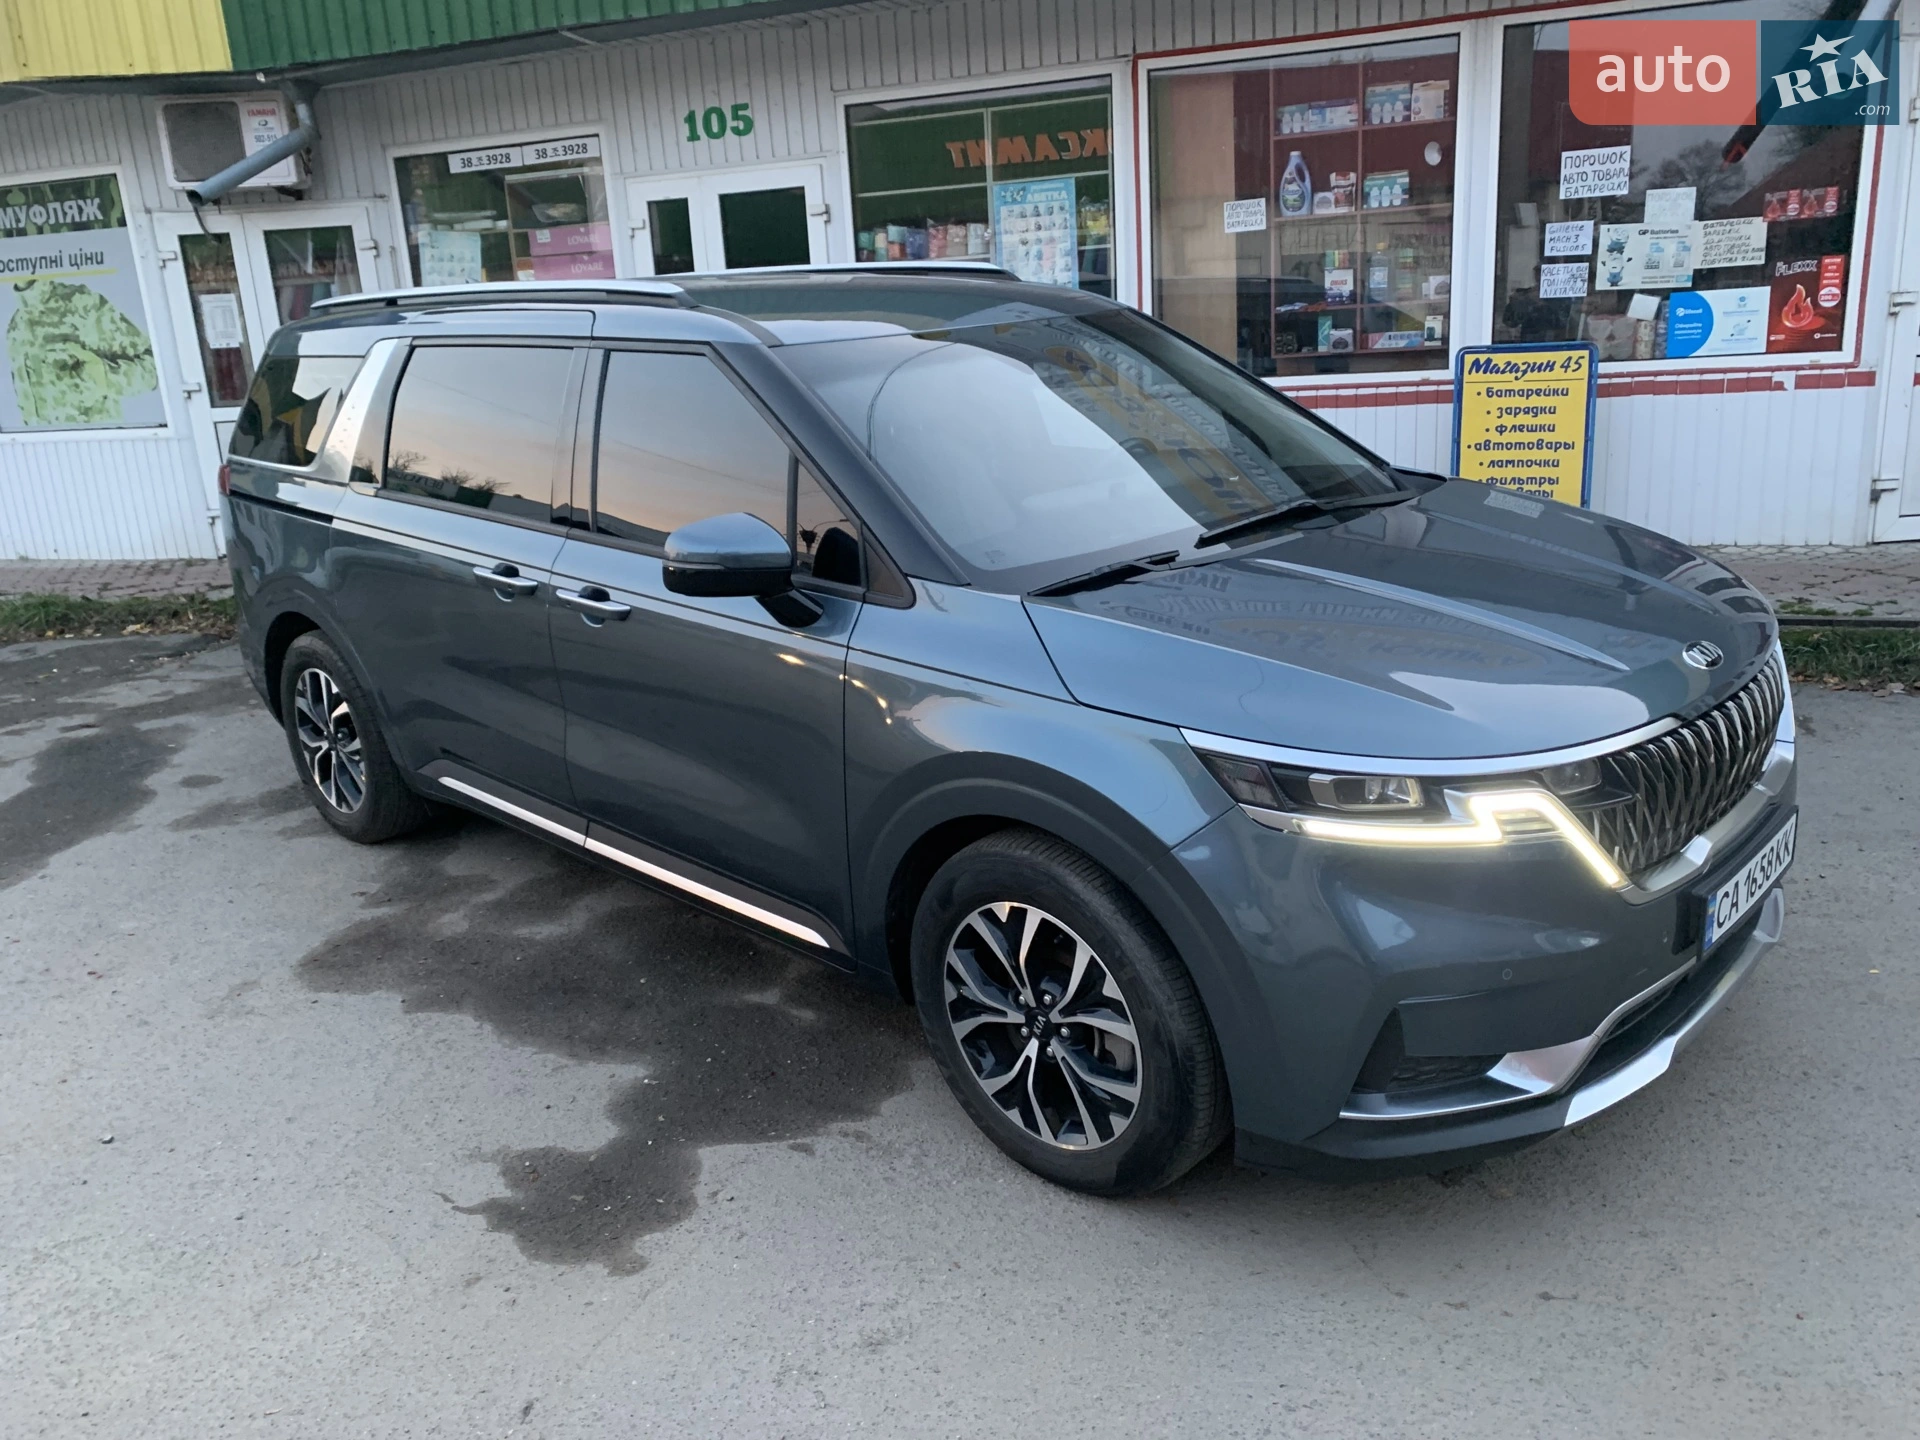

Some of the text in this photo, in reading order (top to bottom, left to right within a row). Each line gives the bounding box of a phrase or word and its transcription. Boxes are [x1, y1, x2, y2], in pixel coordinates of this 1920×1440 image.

[684, 102, 754, 142] 105
[1563, 150, 1628, 170] ПОРОШОК
[1562, 170, 1589, 186] АВТО
[1572, 234, 1581, 244] 3
[68, 248, 105, 270] ціни
[1468, 355, 1586, 381] Магазин 45
[1486, 385, 1569, 400] батарейки
[1496, 405, 1557, 419] зарядки
[1495, 423, 1556, 436] флешки
[1474, 438, 1575, 453] автотовары
[1487, 458, 1560, 469] лампочки
[1485, 475, 1560, 488] фильтры
